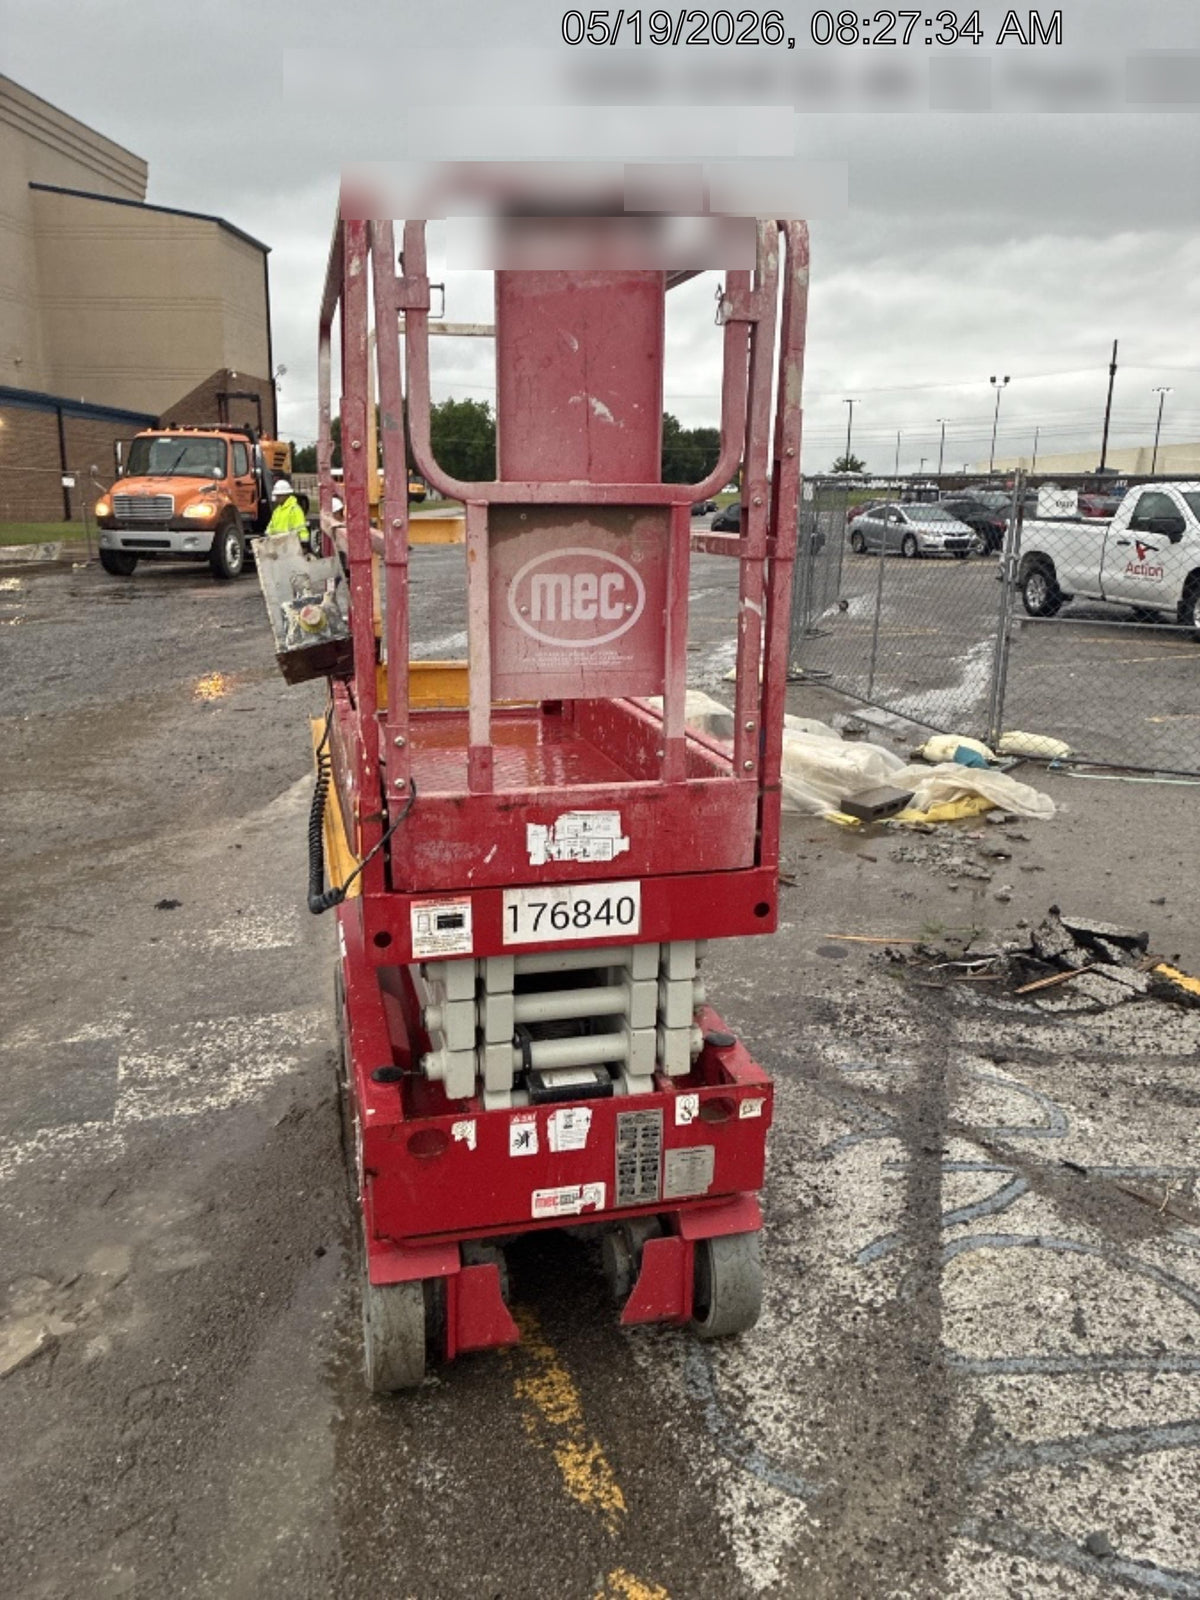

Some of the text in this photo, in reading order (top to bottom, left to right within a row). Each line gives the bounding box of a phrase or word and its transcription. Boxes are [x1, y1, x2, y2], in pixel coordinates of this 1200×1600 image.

[1125, 562, 1164, 583] Action
[530, 573, 625, 621] mec
[507, 896, 636, 933] 176840
